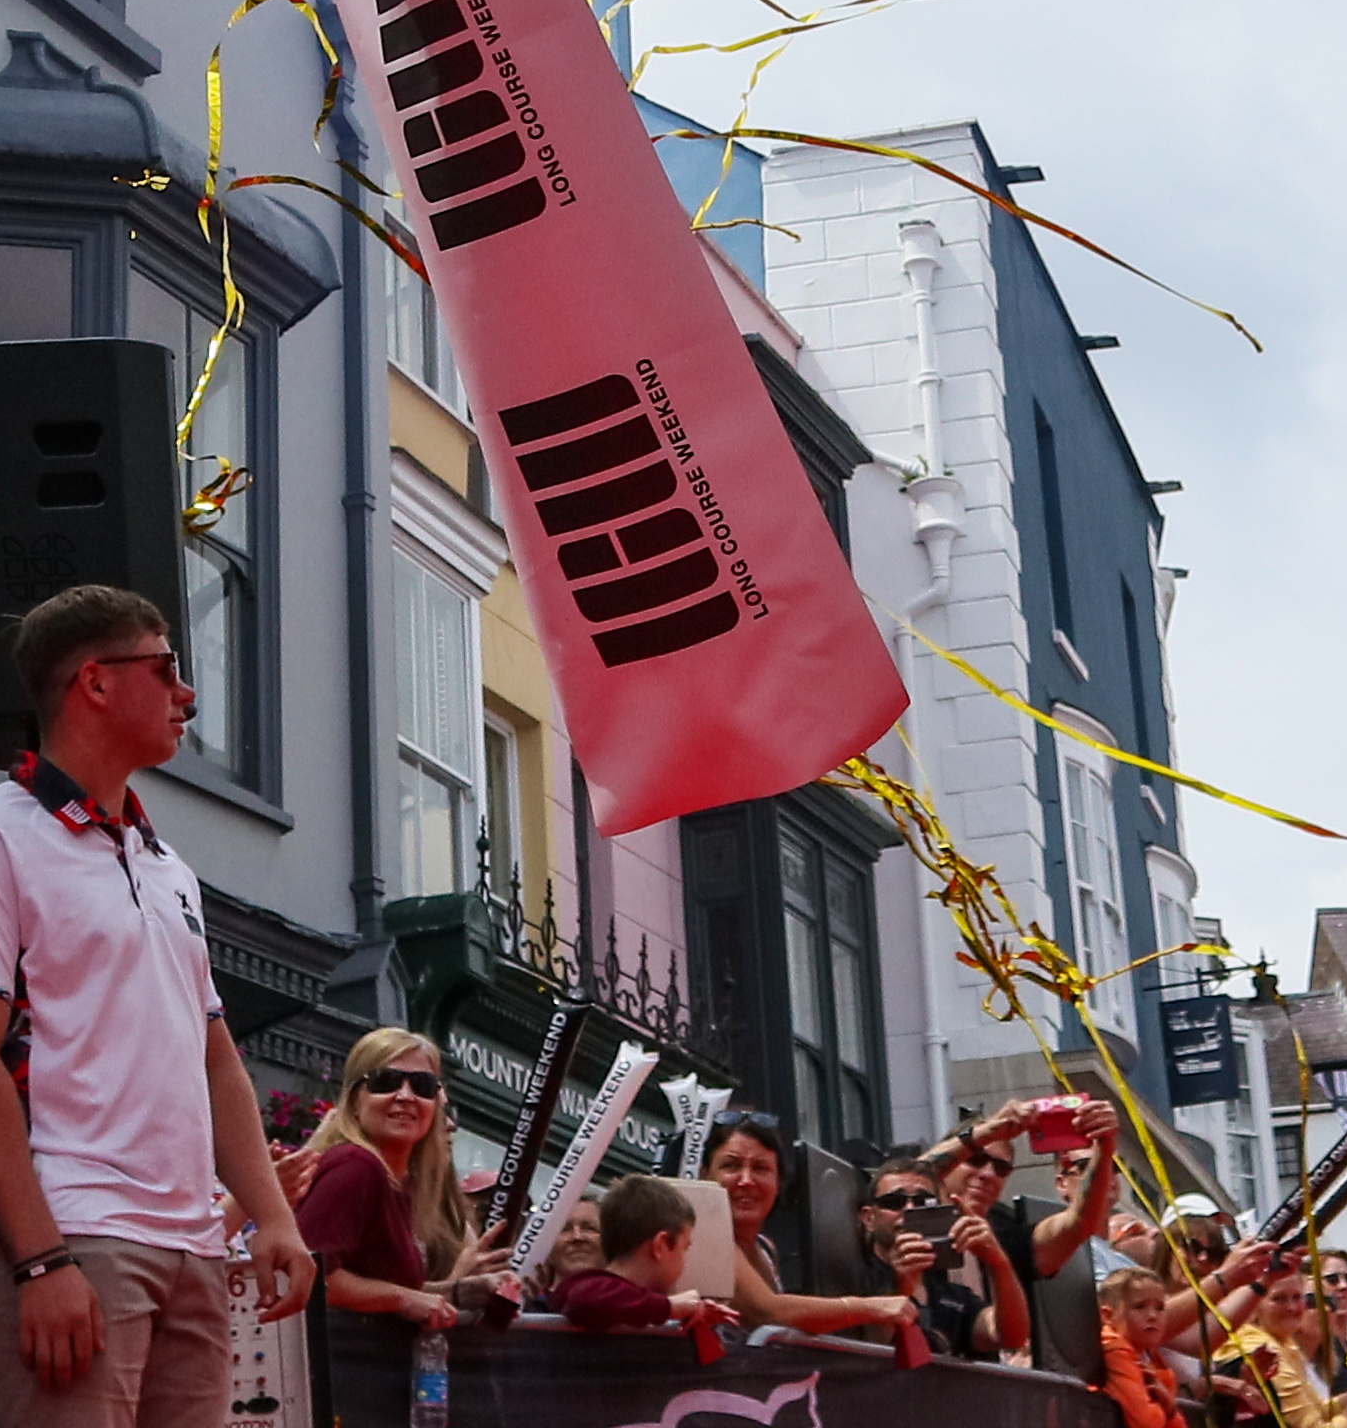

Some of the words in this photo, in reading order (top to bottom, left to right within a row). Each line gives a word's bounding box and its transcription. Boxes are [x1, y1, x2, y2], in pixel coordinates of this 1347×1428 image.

[492, 48, 538, 135] COURSE
[536, 141, 578, 208] LONG
[635, 358, 694, 470] WEEKEND
[690, 468, 742, 555] COURSE
[730, 555, 769, 622] LONG
[449, 1032, 533, 1096] MOUNTA
[485, 1189, 507, 1232] ONG
[499, 1109, 536, 1186] COURSE
[524, 1010, 568, 1105] WEEKEND
[514, 1213, 545, 1265] LONG
[542, 1141, 585, 1215] COURSE
[579, 1059, 632, 1139] WEEKEND
